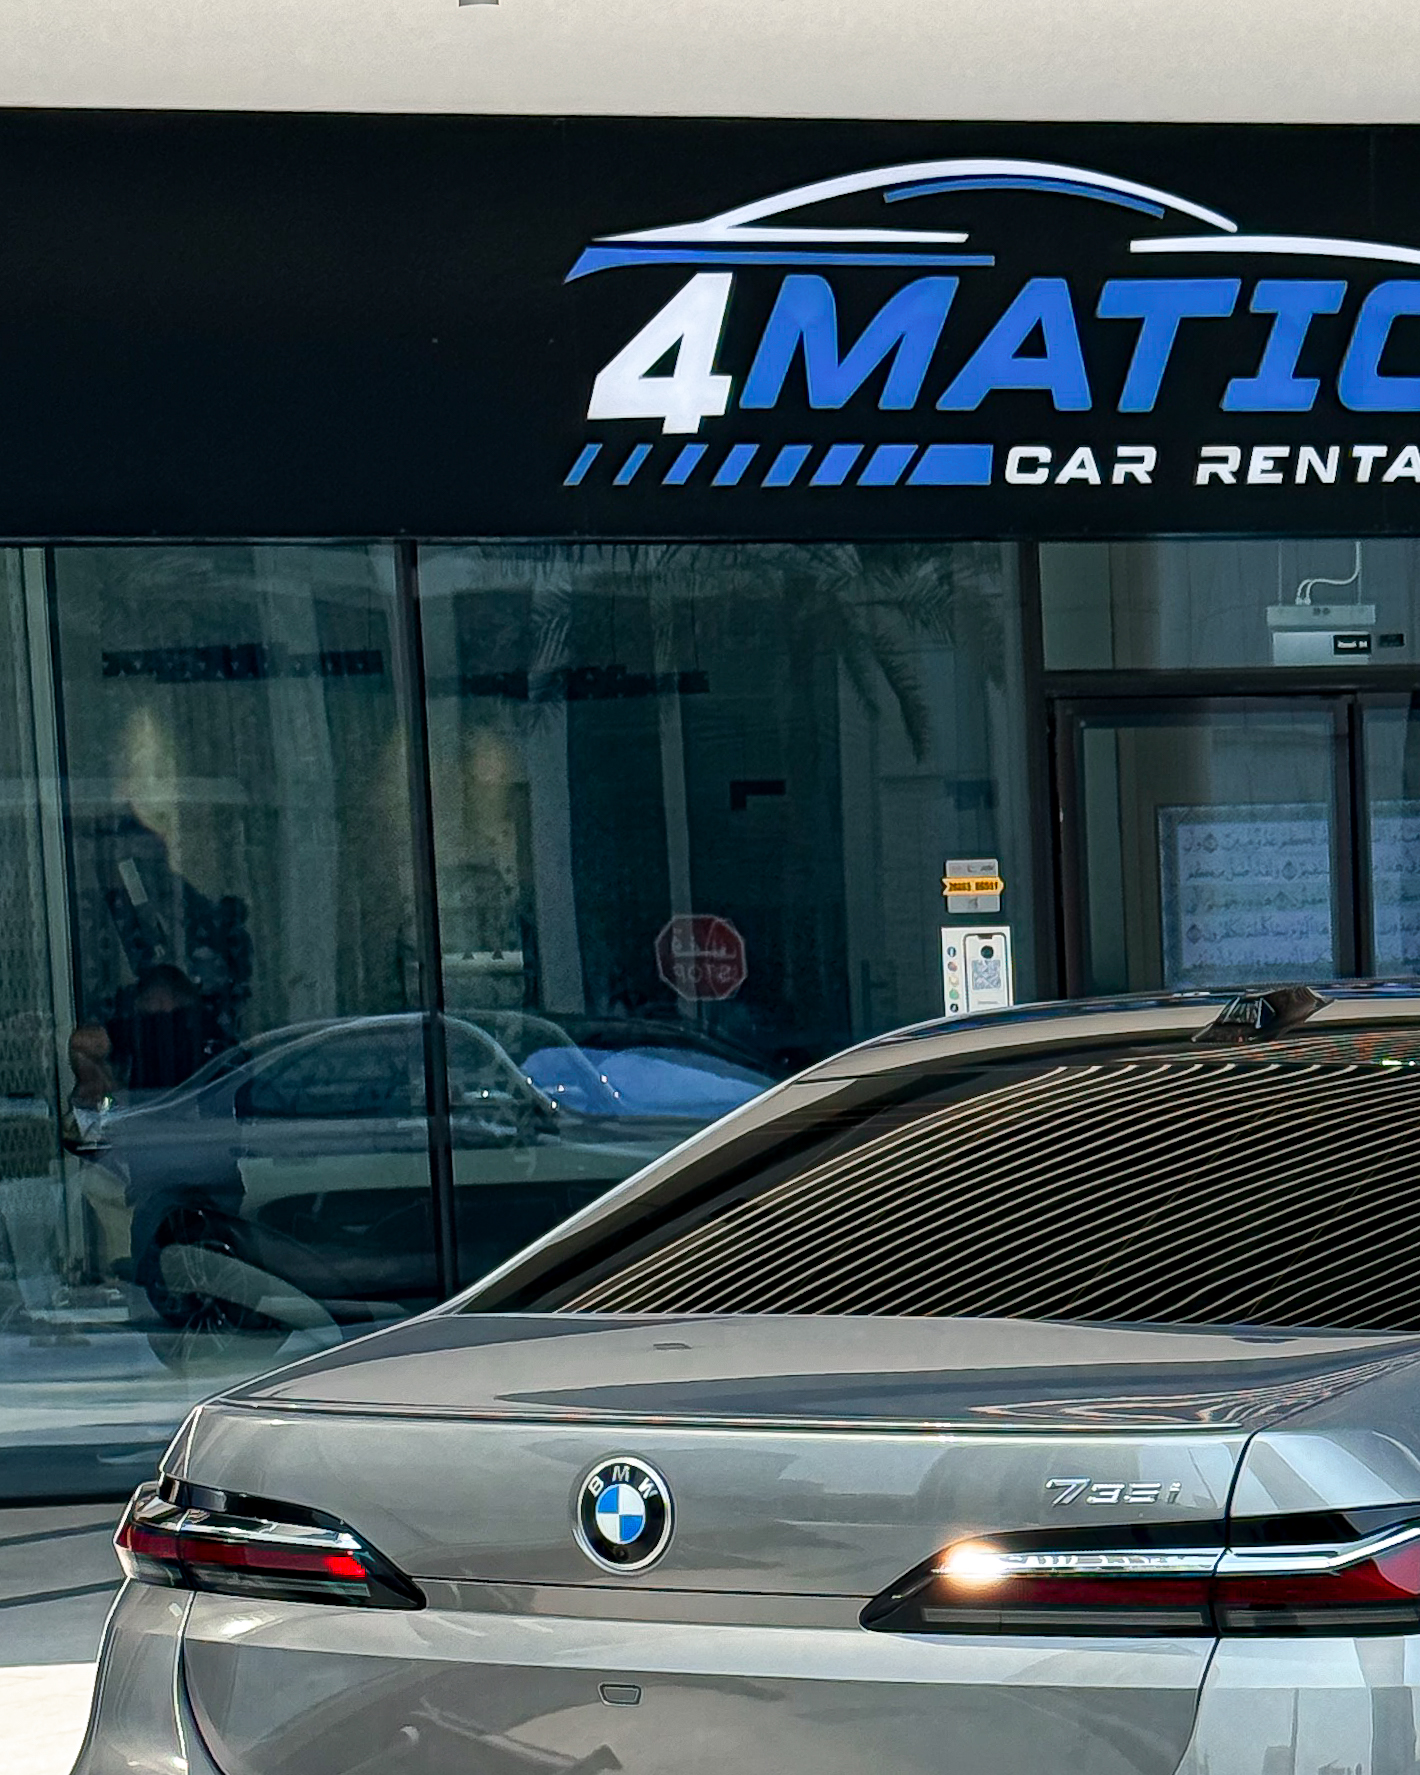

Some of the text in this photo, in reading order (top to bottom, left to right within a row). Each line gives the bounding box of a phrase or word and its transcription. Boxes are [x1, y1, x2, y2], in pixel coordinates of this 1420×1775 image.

[1004, 445, 1157, 484] CAR
[587, 1465, 659, 1500] BMW
[1045, 1477, 1183, 1507] 735i
